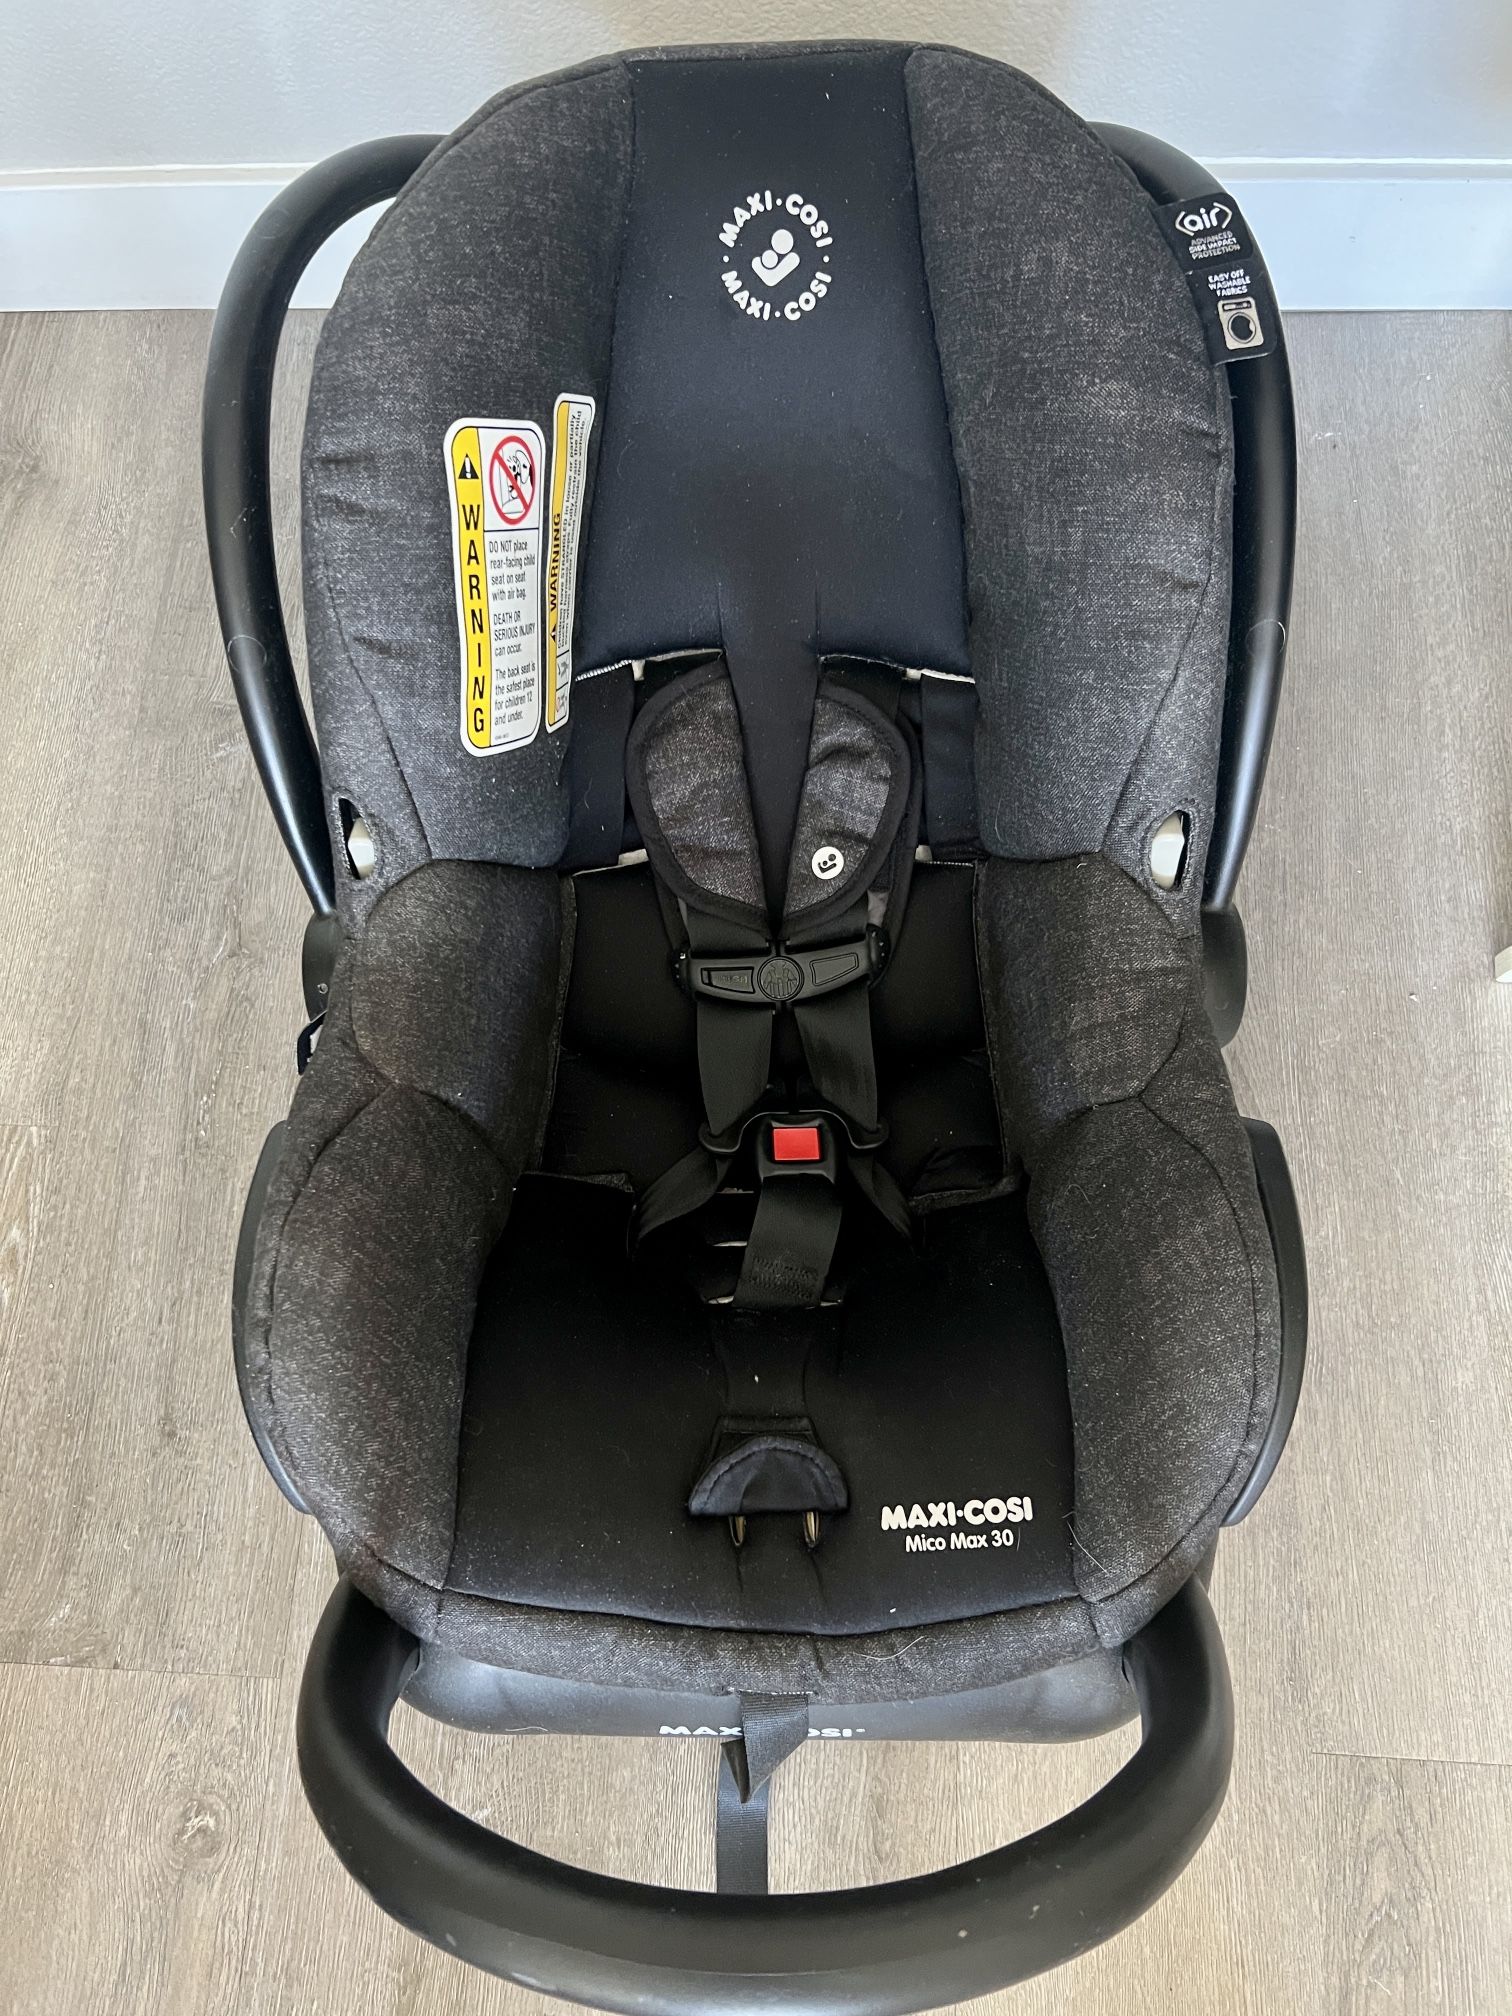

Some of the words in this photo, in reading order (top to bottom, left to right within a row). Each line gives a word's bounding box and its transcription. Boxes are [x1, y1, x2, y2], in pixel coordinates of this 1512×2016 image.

[1189, 244, 1207, 254] SIDE
[1207, 238, 1237, 250] IMPACT
[1191, 231, 1233, 246] ADVANCED
[1192, 244, 1241, 260] PROTECTION
[1208, 272, 1230, 283] EASY
[1230, 269, 1245, 279] OFF
[1208, 276, 1251, 291] WASHABLE
[1216, 286, 1248, 297] FABRICS
[489, 540, 498, 552] DO
[500, 540, 512, 552] NOT
[514, 540, 527, 556] place
[490, 556, 522, 570] rear-facing
[524, 553, 535, 566] child
[550, 513, 560, 611] WARNING
[491, 573, 505, 585] seat
[507, 574, 513, 584] on
[515, 571, 525, 583] seat
[492, 589, 506, 601] with
[462, 504, 485, 732] WARNING
[494, 612, 512, 625] DEATH
[514, 610, 520, 622] OR
[494, 626, 518, 641] SERIOUS
[519, 623, 535, 637] INJURY
[495, 647, 505, 656] can
[496, 669, 505, 680] The
[508, 665, 519, 678] back
[521, 663, 530, 674] seat
[495, 685, 504, 695] the
[506, 681, 521, 693] safest
[523, 678, 534, 691] place
[495, 700, 503, 710] for
[505, 695, 525, 708] children
[527, 691, 532, 702] 12
[495, 713, 506, 725] and
[905, 1534, 946, 1552] Mico
[950, 1532, 988, 1549] Max
[991, 1529, 1014, 1546] 30
